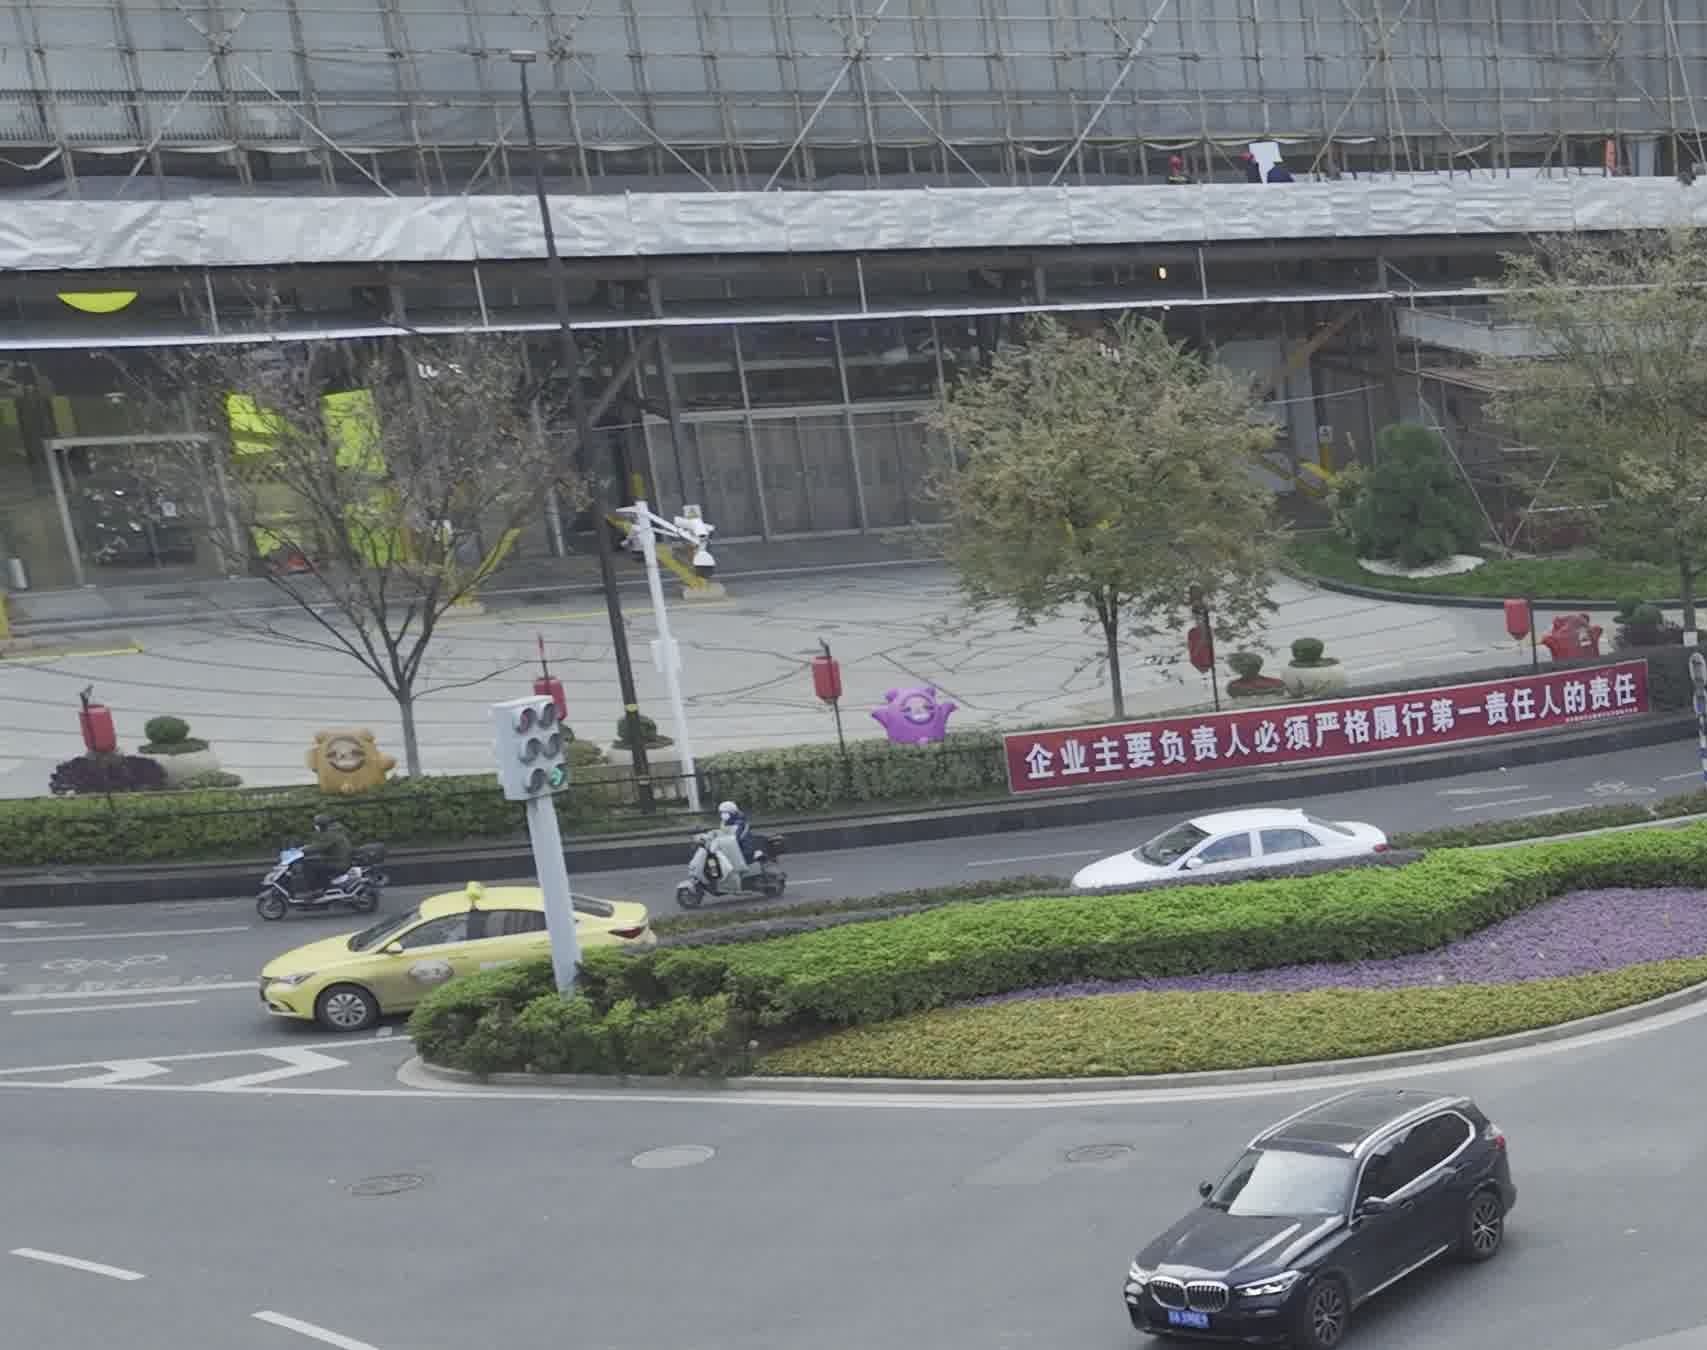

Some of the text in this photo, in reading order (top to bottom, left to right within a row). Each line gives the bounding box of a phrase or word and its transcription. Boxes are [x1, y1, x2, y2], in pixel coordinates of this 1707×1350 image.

[1025, 672, 1638, 780] 企业主要负责人必须严格履行第一责任人的责任
